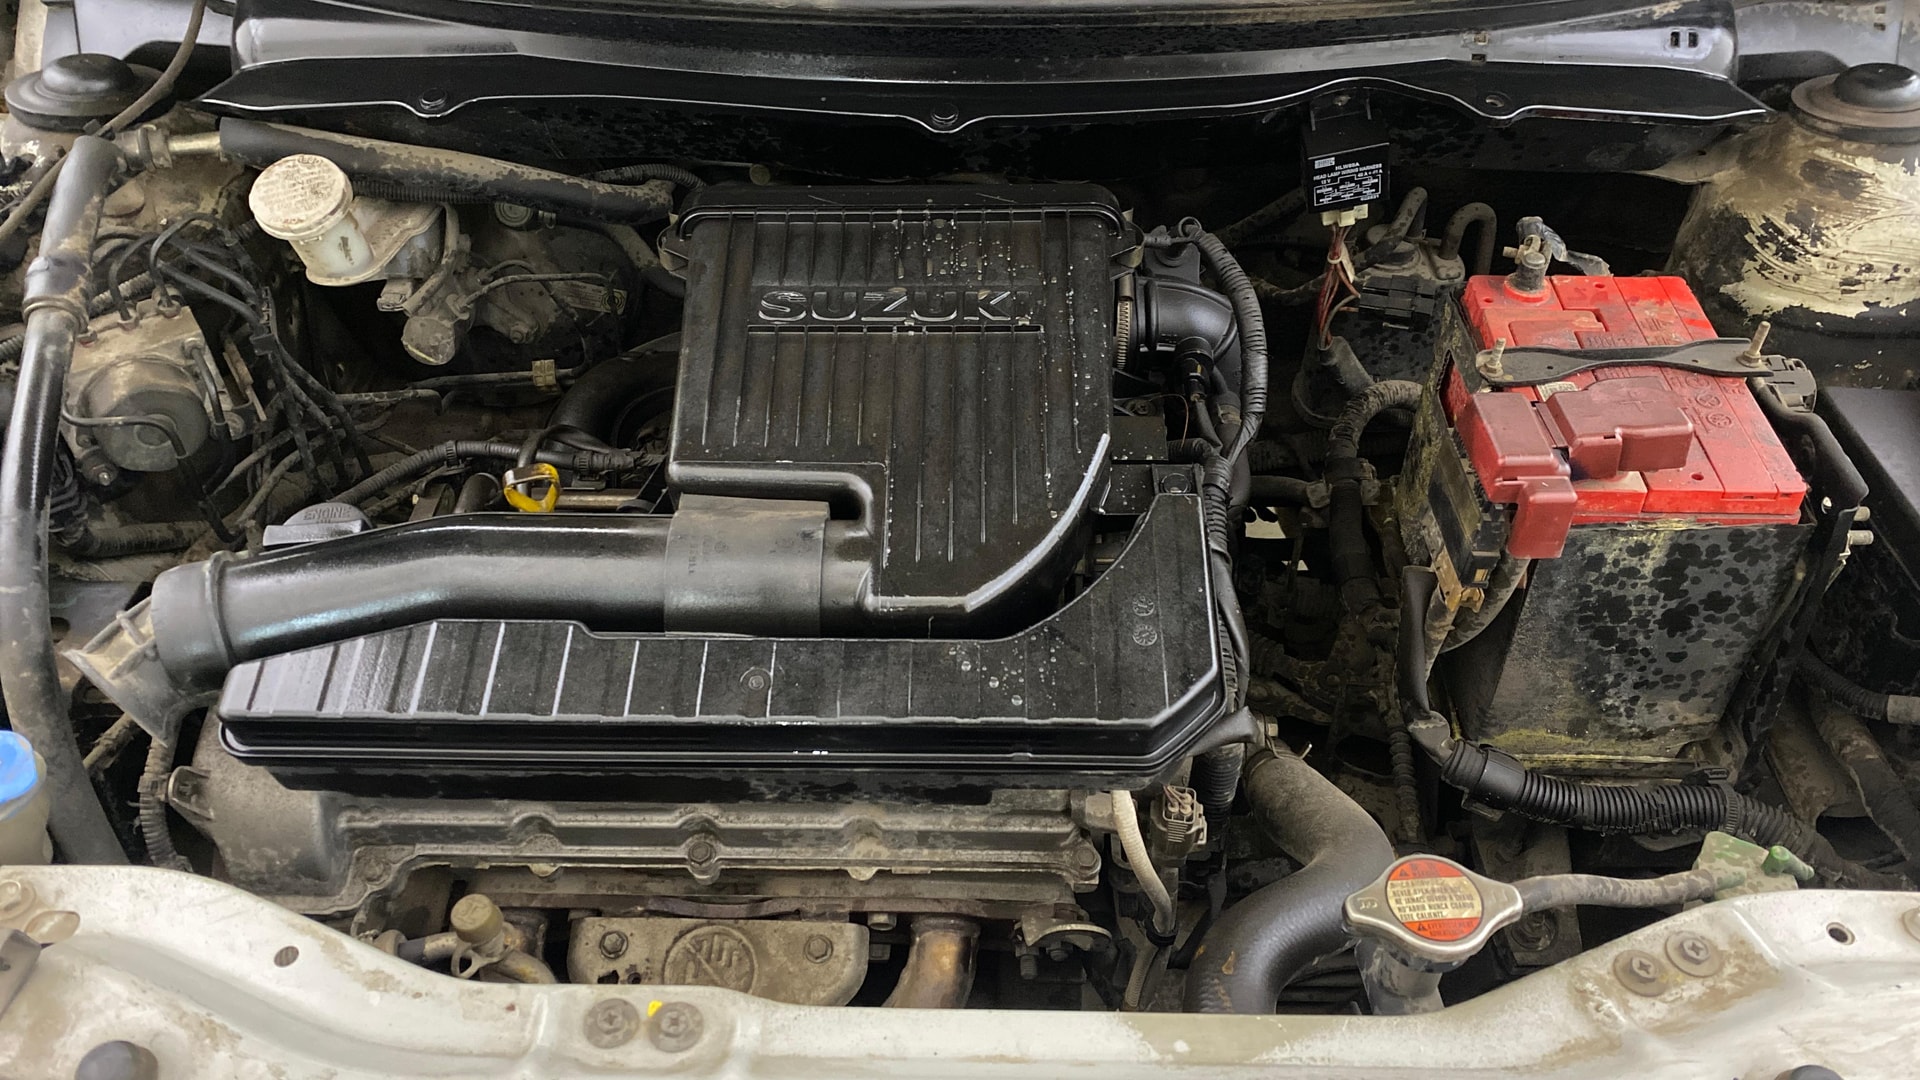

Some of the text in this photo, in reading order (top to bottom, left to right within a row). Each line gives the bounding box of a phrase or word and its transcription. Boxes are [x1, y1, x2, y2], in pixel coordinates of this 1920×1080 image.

[758, 289, 1032, 322] SUZUKI
[304, 507, 352, 520] ENGINE
[1392, 889, 1412, 897] NEVER
[1395, 897, 1403, 905] NE
[1397, 901, 1475, 913] NO ABRIR NUNCA CUANDO
[1400, 913, 1415, 921] ESTE
